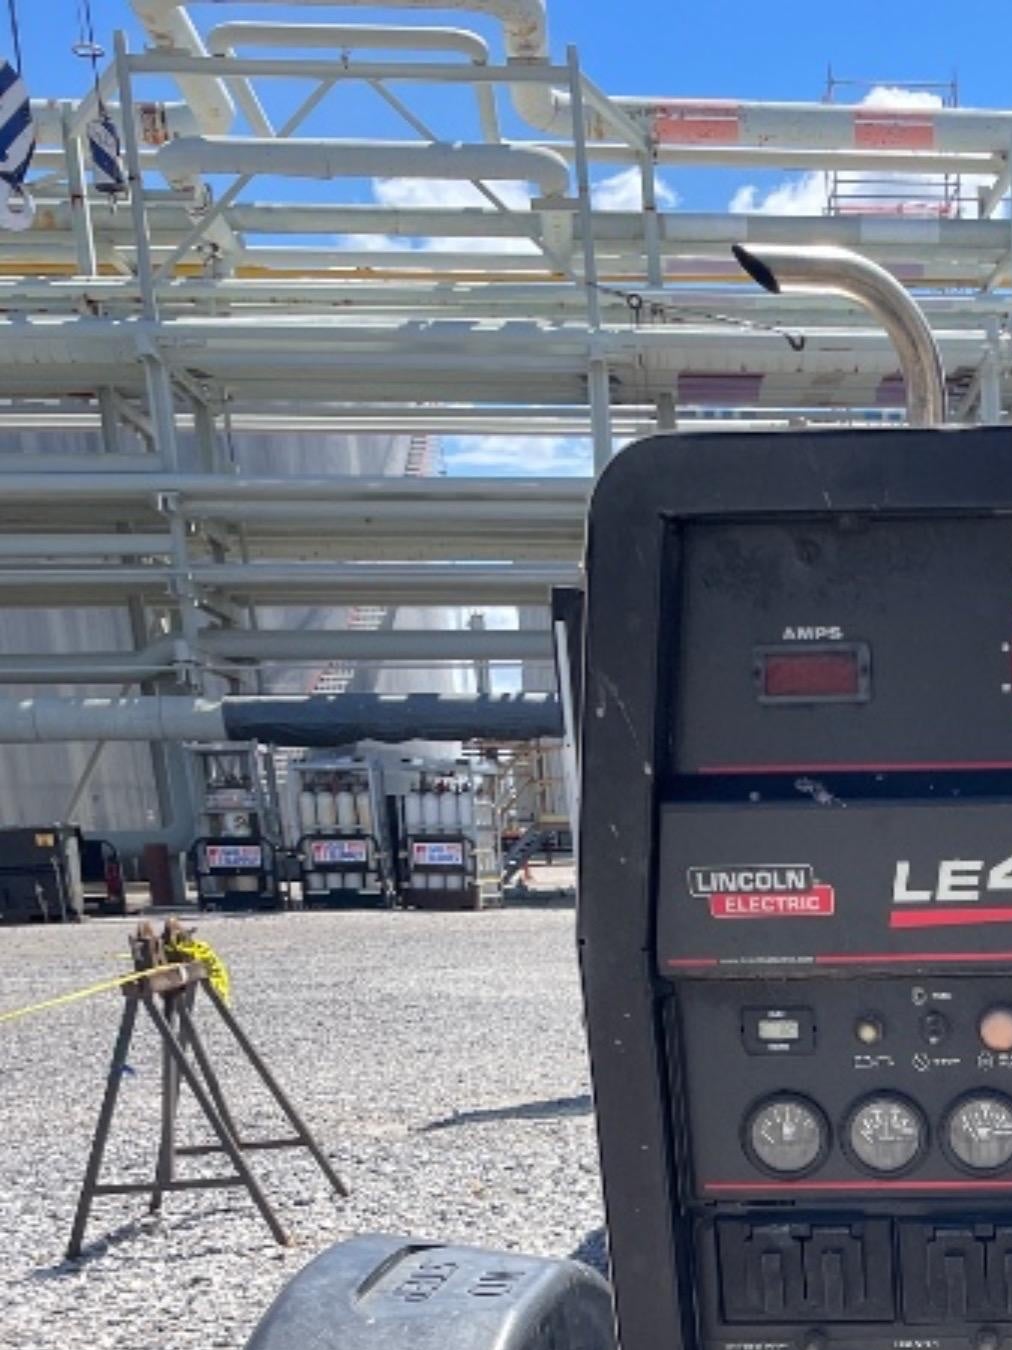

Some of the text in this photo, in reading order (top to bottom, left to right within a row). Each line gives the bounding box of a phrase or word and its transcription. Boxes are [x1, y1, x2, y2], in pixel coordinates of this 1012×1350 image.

[782, 626, 844, 641] AMPS
[696, 871, 806, 893] LINCOLN
[725, 896, 820, 913] ELECTRIC
